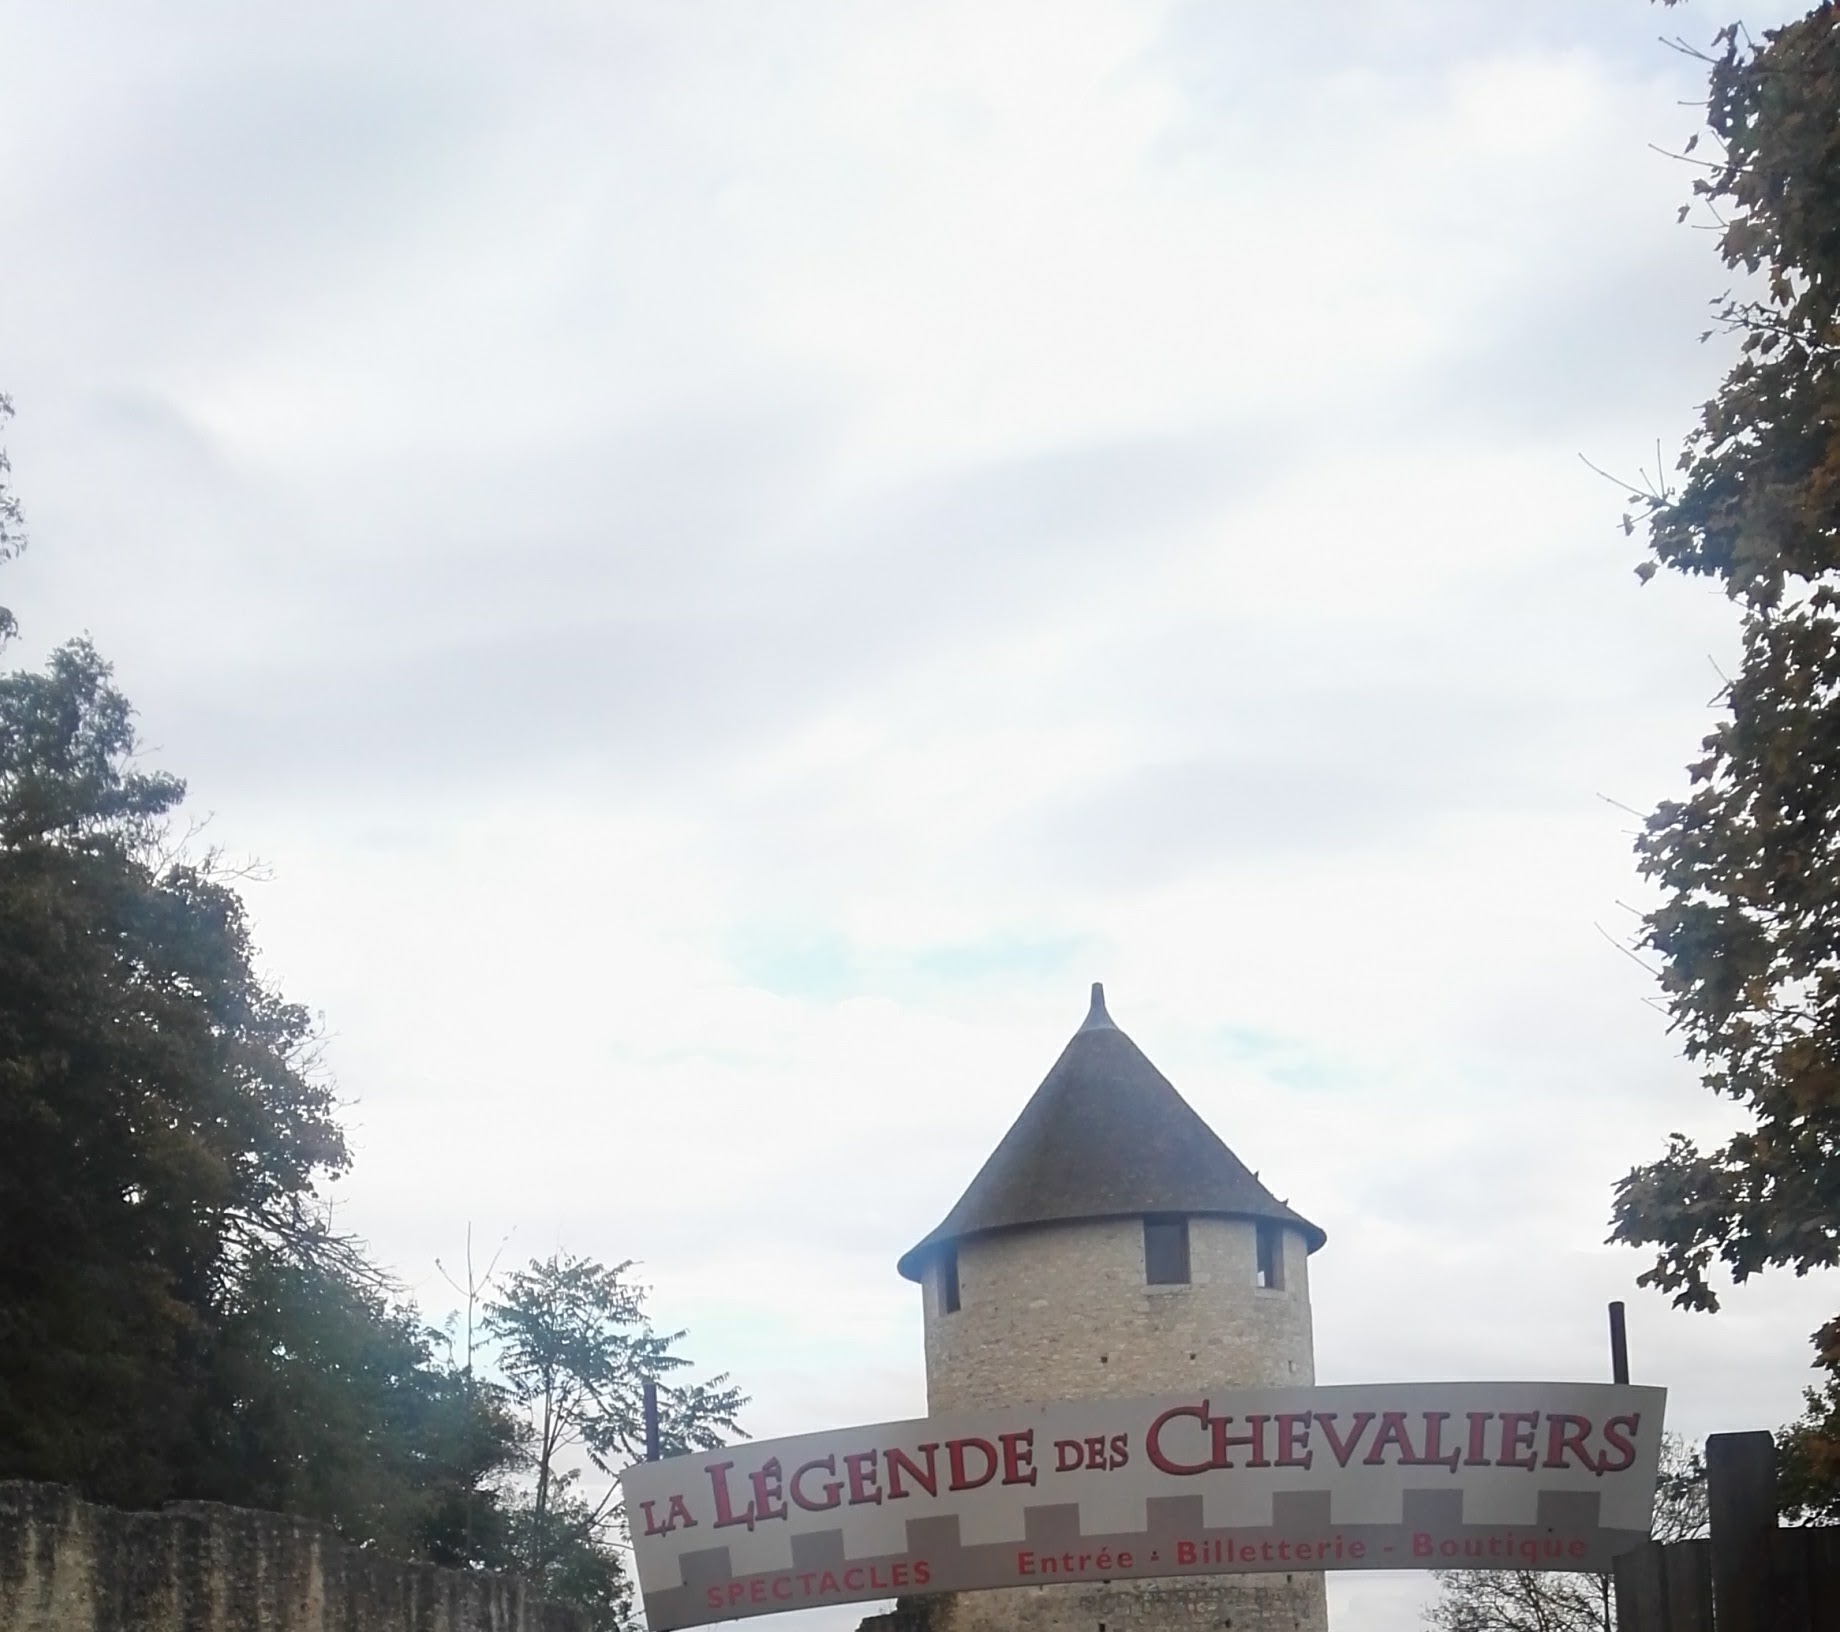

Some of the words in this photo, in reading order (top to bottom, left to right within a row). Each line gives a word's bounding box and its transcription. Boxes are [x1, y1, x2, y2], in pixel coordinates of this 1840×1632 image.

[639, 1494, 698, 1538] LA
[704, 1427, 1038, 1531] LÉGENDE
[1053, 1432, 1129, 1473] DES
[1145, 1399, 1641, 1476] CHEVALIERS
[1017, 1546, 1134, 1576] Entrée
[1176, 1531, 1367, 1566] Billetterie
[1411, 1532, 1587, 1562] Boutique
[706, 1560, 932, 1609] SPECTACLES
